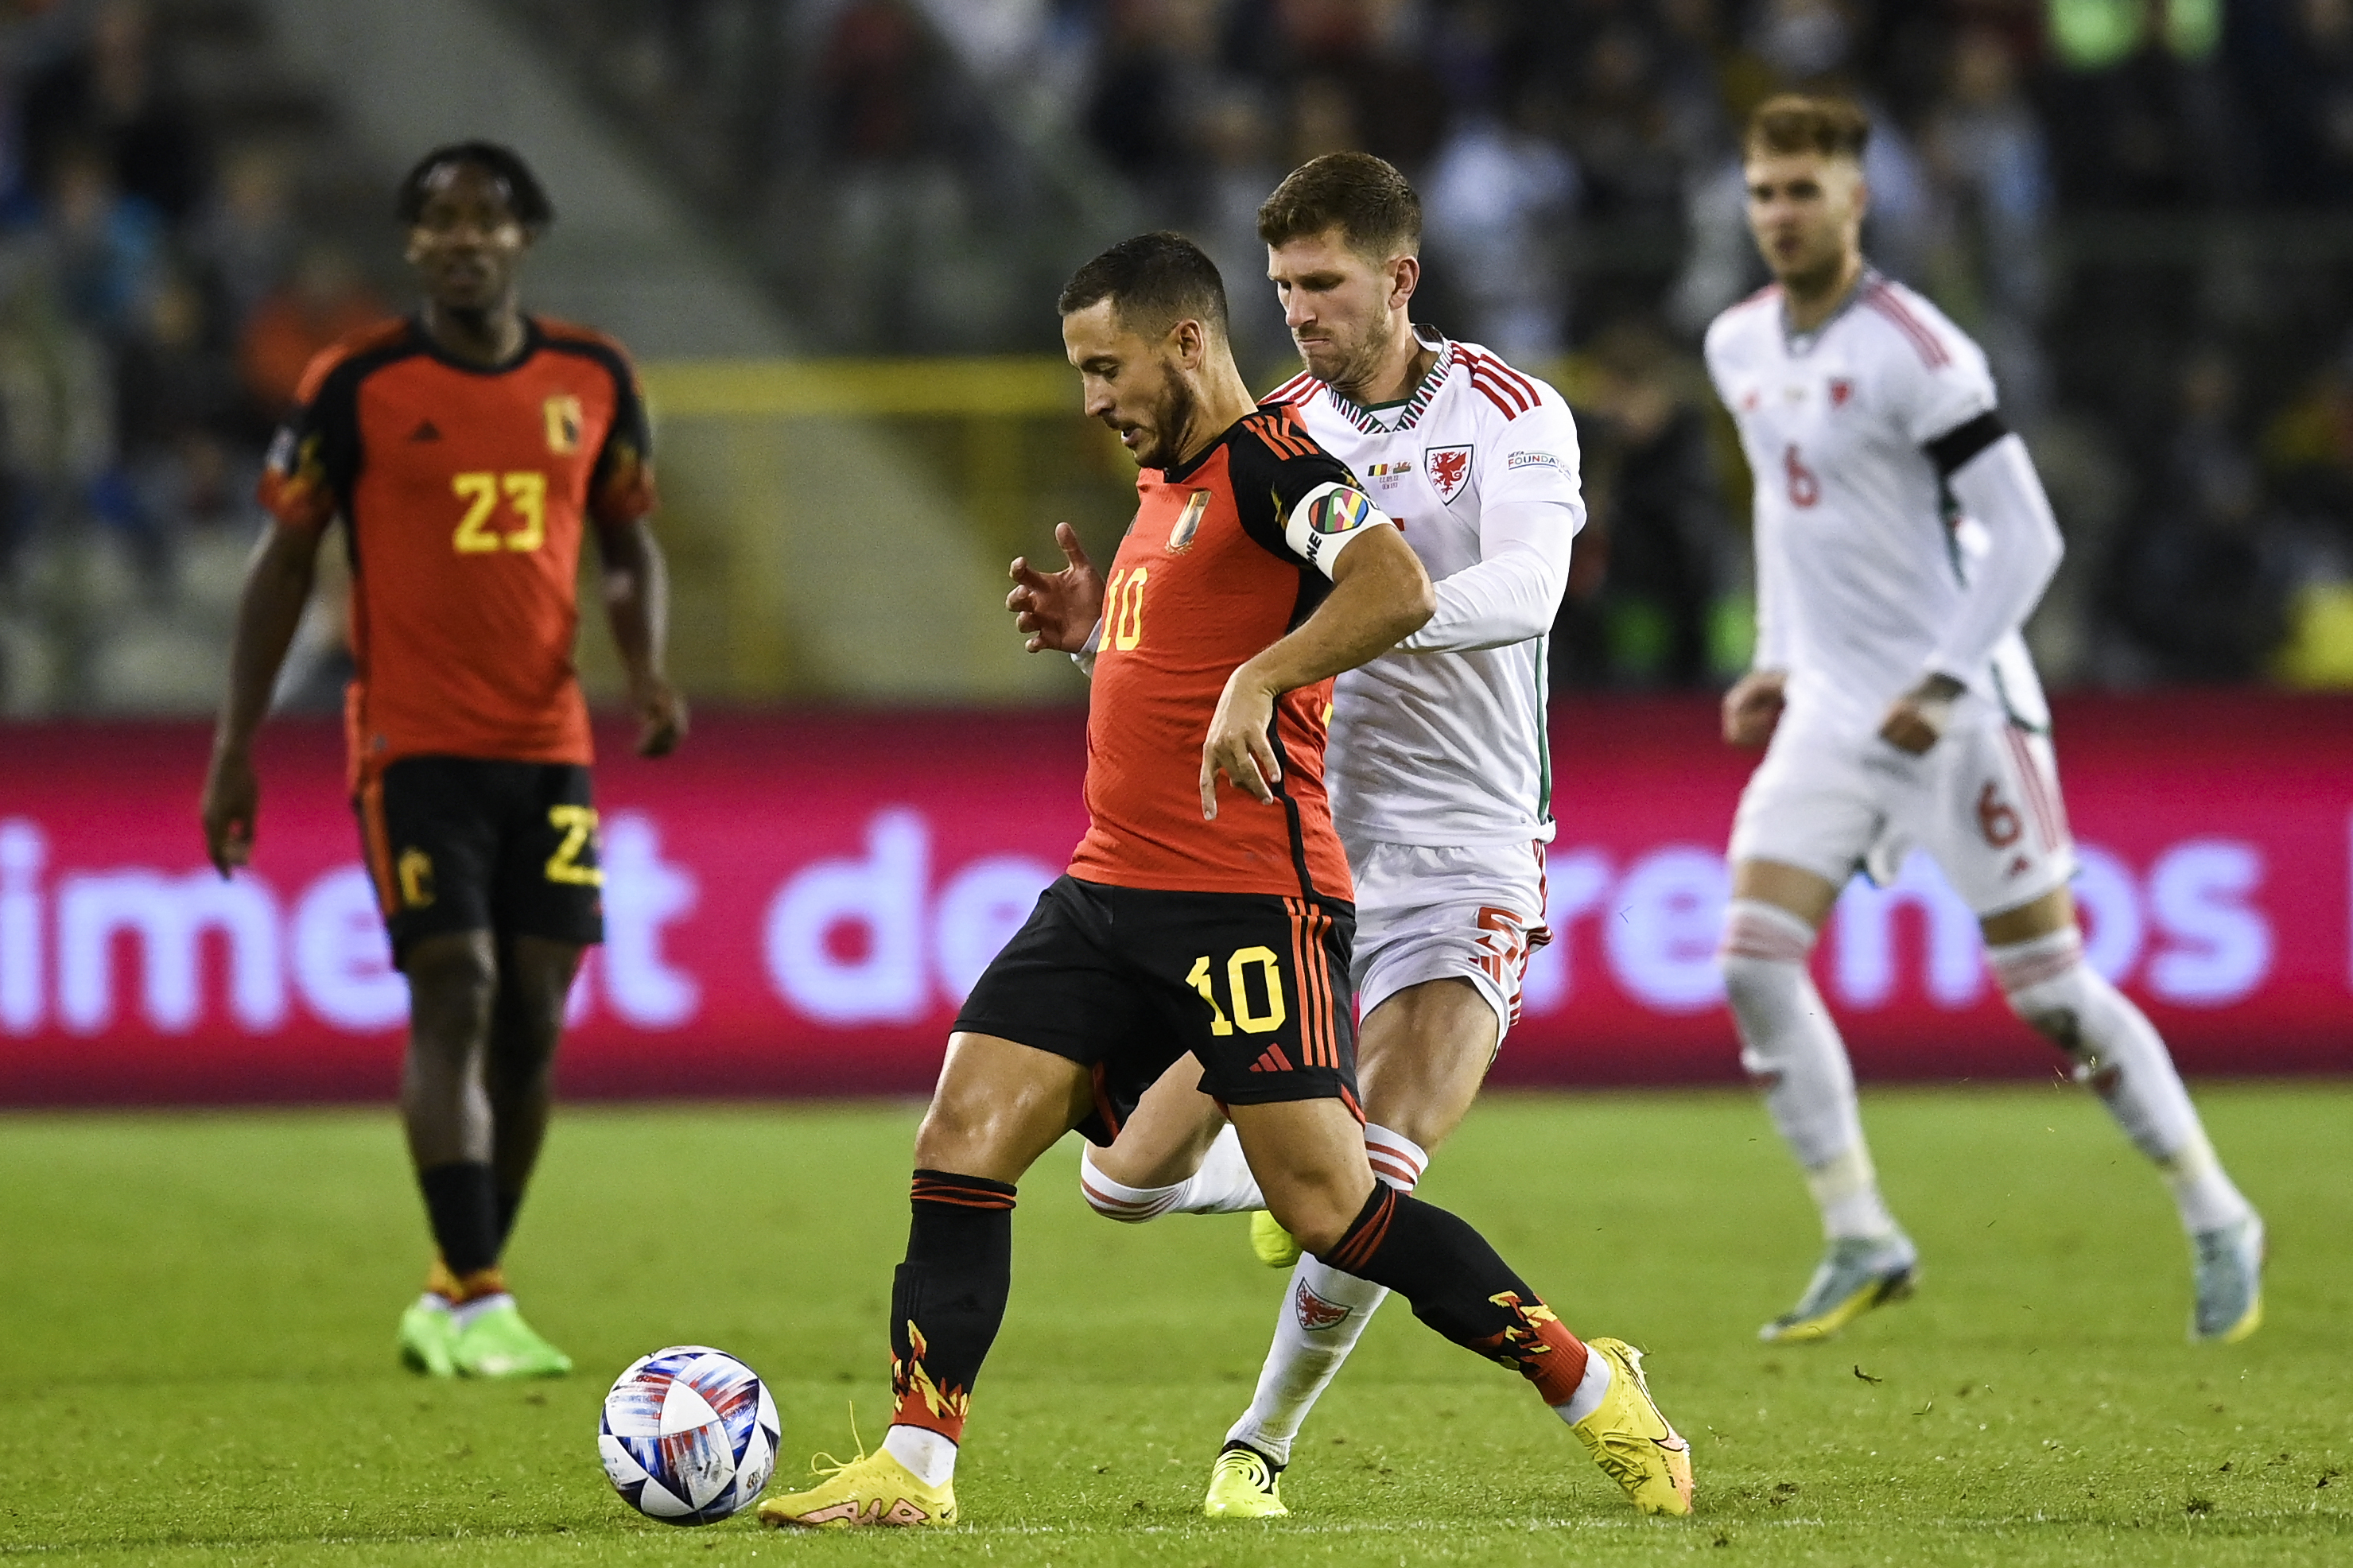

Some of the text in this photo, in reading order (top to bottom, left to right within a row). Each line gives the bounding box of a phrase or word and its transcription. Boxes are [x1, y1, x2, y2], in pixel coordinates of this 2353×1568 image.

[452, 471, 547, 553] 23
[1784, 441, 1822, 510] 6
[1097, 567, 1147, 653] 10
[1976, 779, 2024, 850] 6
[1474, 906, 1523, 966] 5
[1185, 945, 1286, 1036] 10
